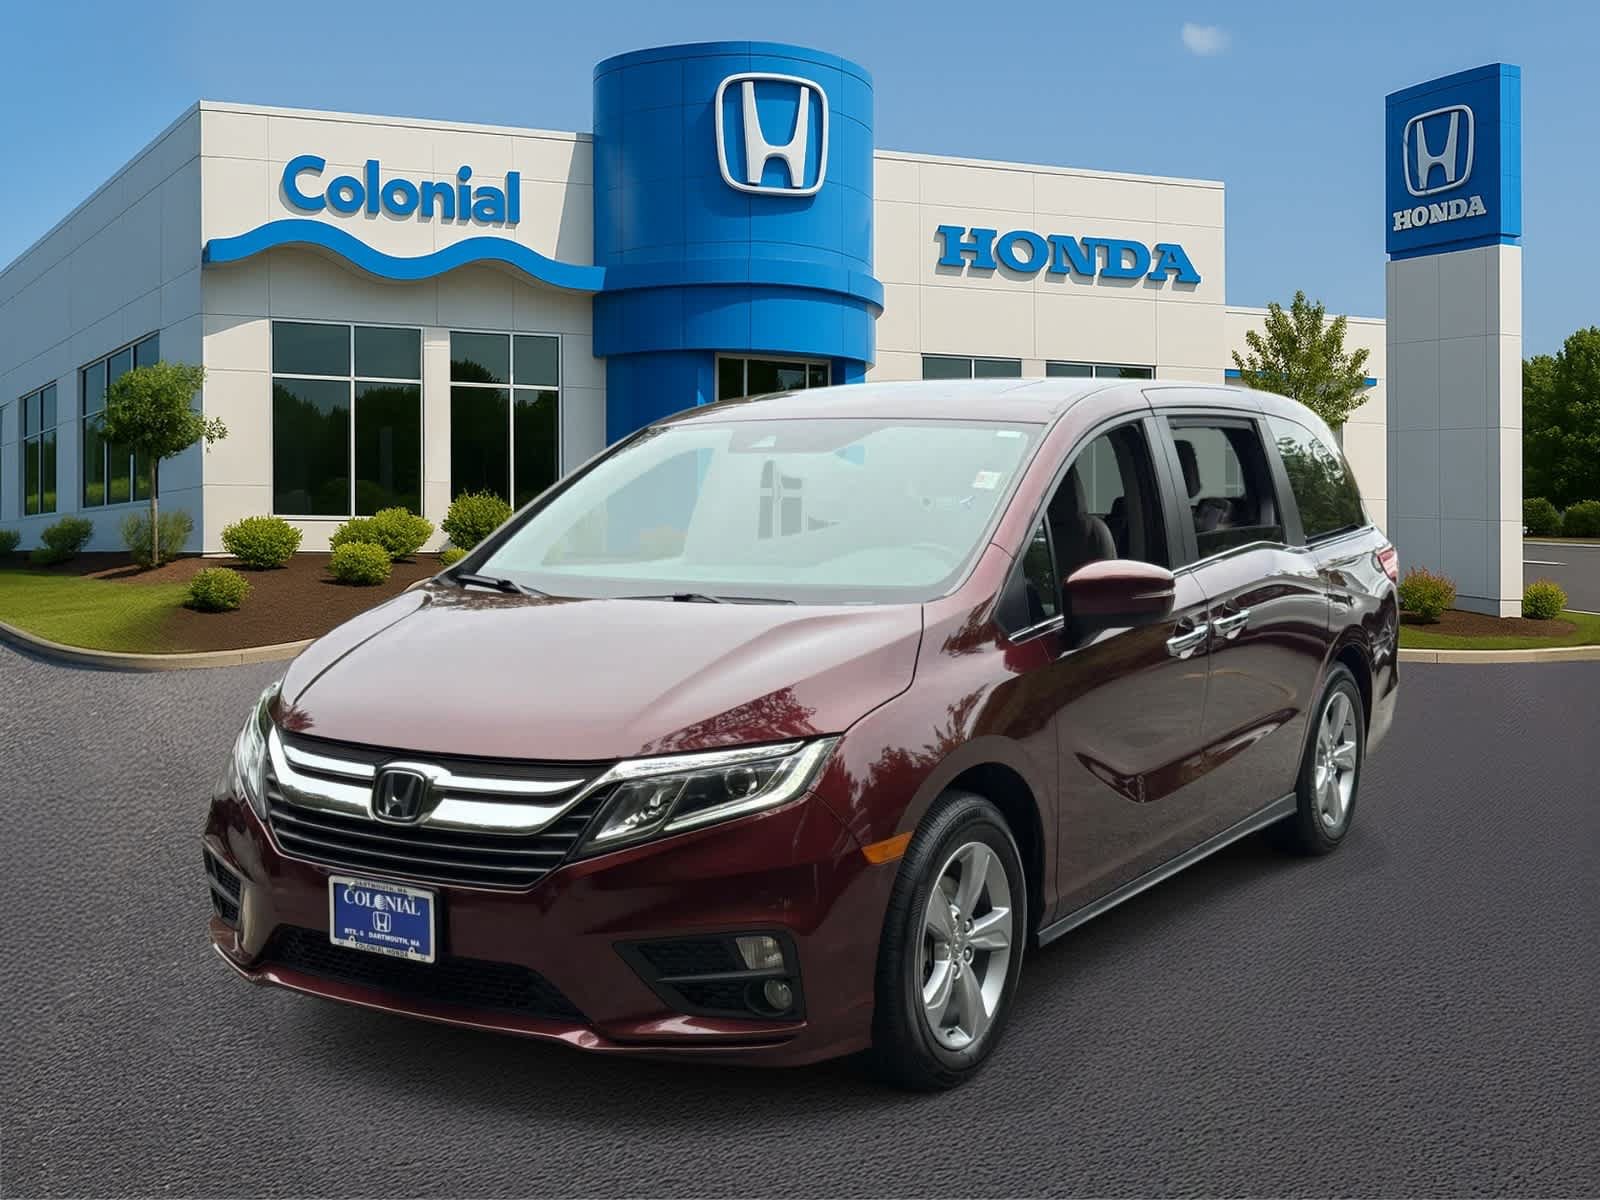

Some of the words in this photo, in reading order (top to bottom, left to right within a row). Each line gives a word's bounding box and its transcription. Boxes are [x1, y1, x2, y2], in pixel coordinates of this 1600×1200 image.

[281, 155, 520, 225] Colonial
[1392, 195, 1487, 233] HONDA
[936, 225, 1201, 285] HONDA
[344, 889, 419, 915] COLONIAL
[344, 927, 359, 936] RTE.
[410, 939, 420, 947] MA
[356, 943, 384, 953] COLONIAL
[386, 948, 408, 957] HONDA
